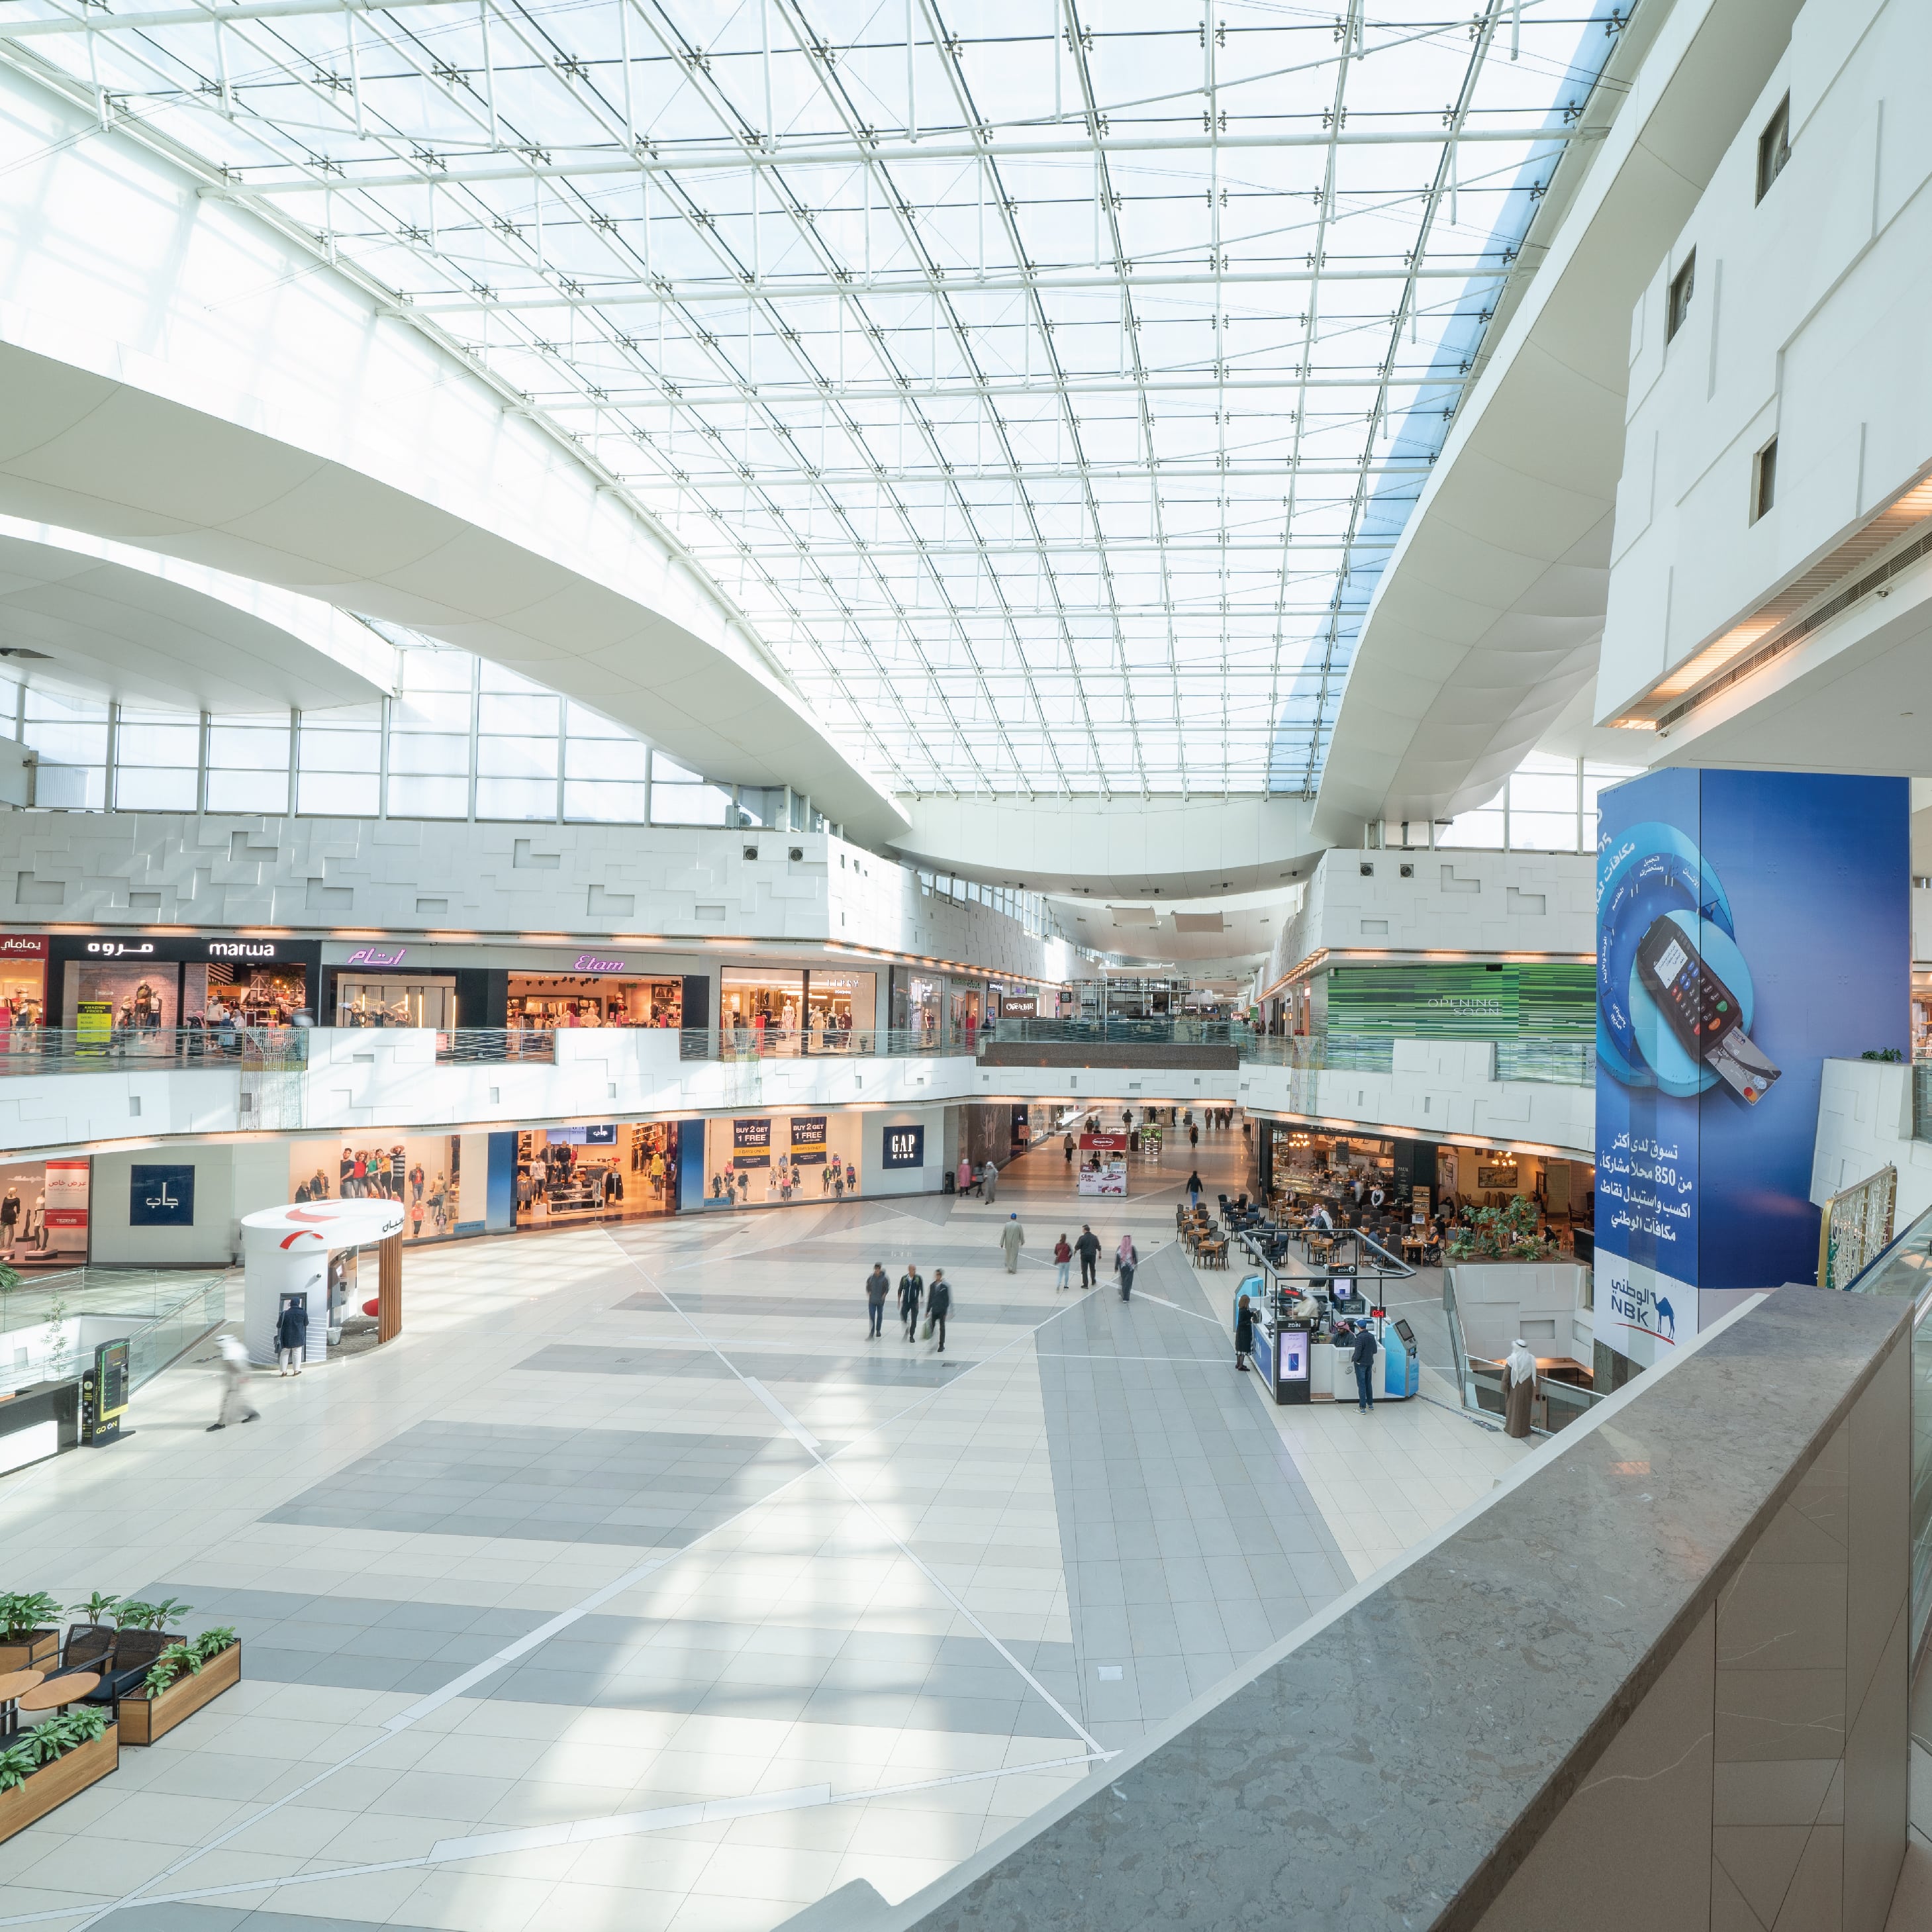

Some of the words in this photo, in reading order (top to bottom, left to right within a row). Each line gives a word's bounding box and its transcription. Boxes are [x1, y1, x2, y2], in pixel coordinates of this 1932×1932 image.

[1605, 842, 1635, 882] مكافآت
[0, 939, 41, 951] يماماي
[209, 943, 274, 957] marwa
[574, 954, 626, 971] Etam
[1427, 998, 1499, 1008] OPENING
[1454, 1008, 1499, 1016] SOON
[893, 1134, 915, 1153] GAP
[1611, 1132, 1630, 1149] أكثر
[1630, 1138, 1649, 1153] لدى
[1650, 1139, 1678, 1161] تسوق
[1630, 1155, 1653, 1180] محلاً
[1655, 1165, 1676, 1186] 850
[1600, 1179, 1622, 1197] نقاط
[1678, 1176, 1692, 1194] من
[146, 1182, 179, 1209] جاب
[1623, 1186, 1662, 1214] واستبدل
[1663, 1202, 1690, 1218] اكسب
[1611, 1210, 1643, 1232] الوطني
[1643, 1217, 1676, 1241] مكافآت
[1612, 1279, 1649, 1306] الوطني
[1612, 1295, 1649, 1327] NBK
[96, 1425, 107, 1434] GO
[107, 1420, 117, 1429] ON
